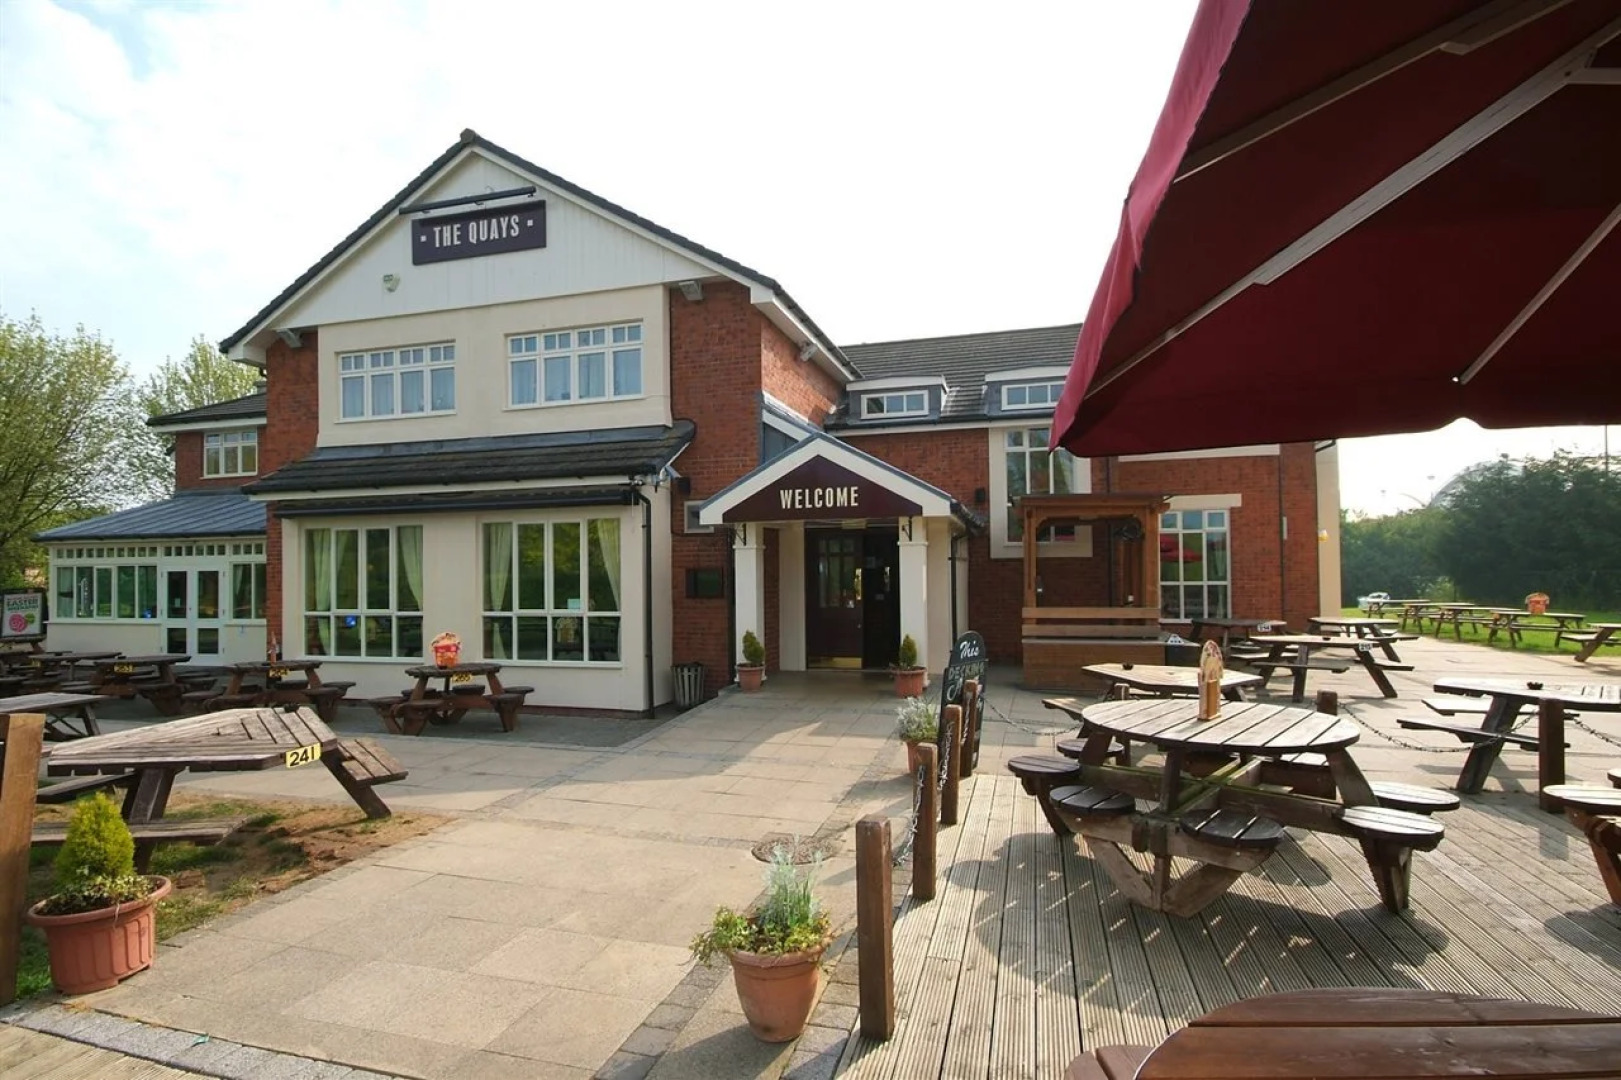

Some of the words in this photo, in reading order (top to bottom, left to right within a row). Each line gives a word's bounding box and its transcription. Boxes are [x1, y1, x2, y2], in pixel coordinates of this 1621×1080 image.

[433, 223, 461, 248] THE
[468, 214, 519, 244] QUAYS
[780, 486, 859, 509] WELCOME
[289, 746, 315, 767] 241
